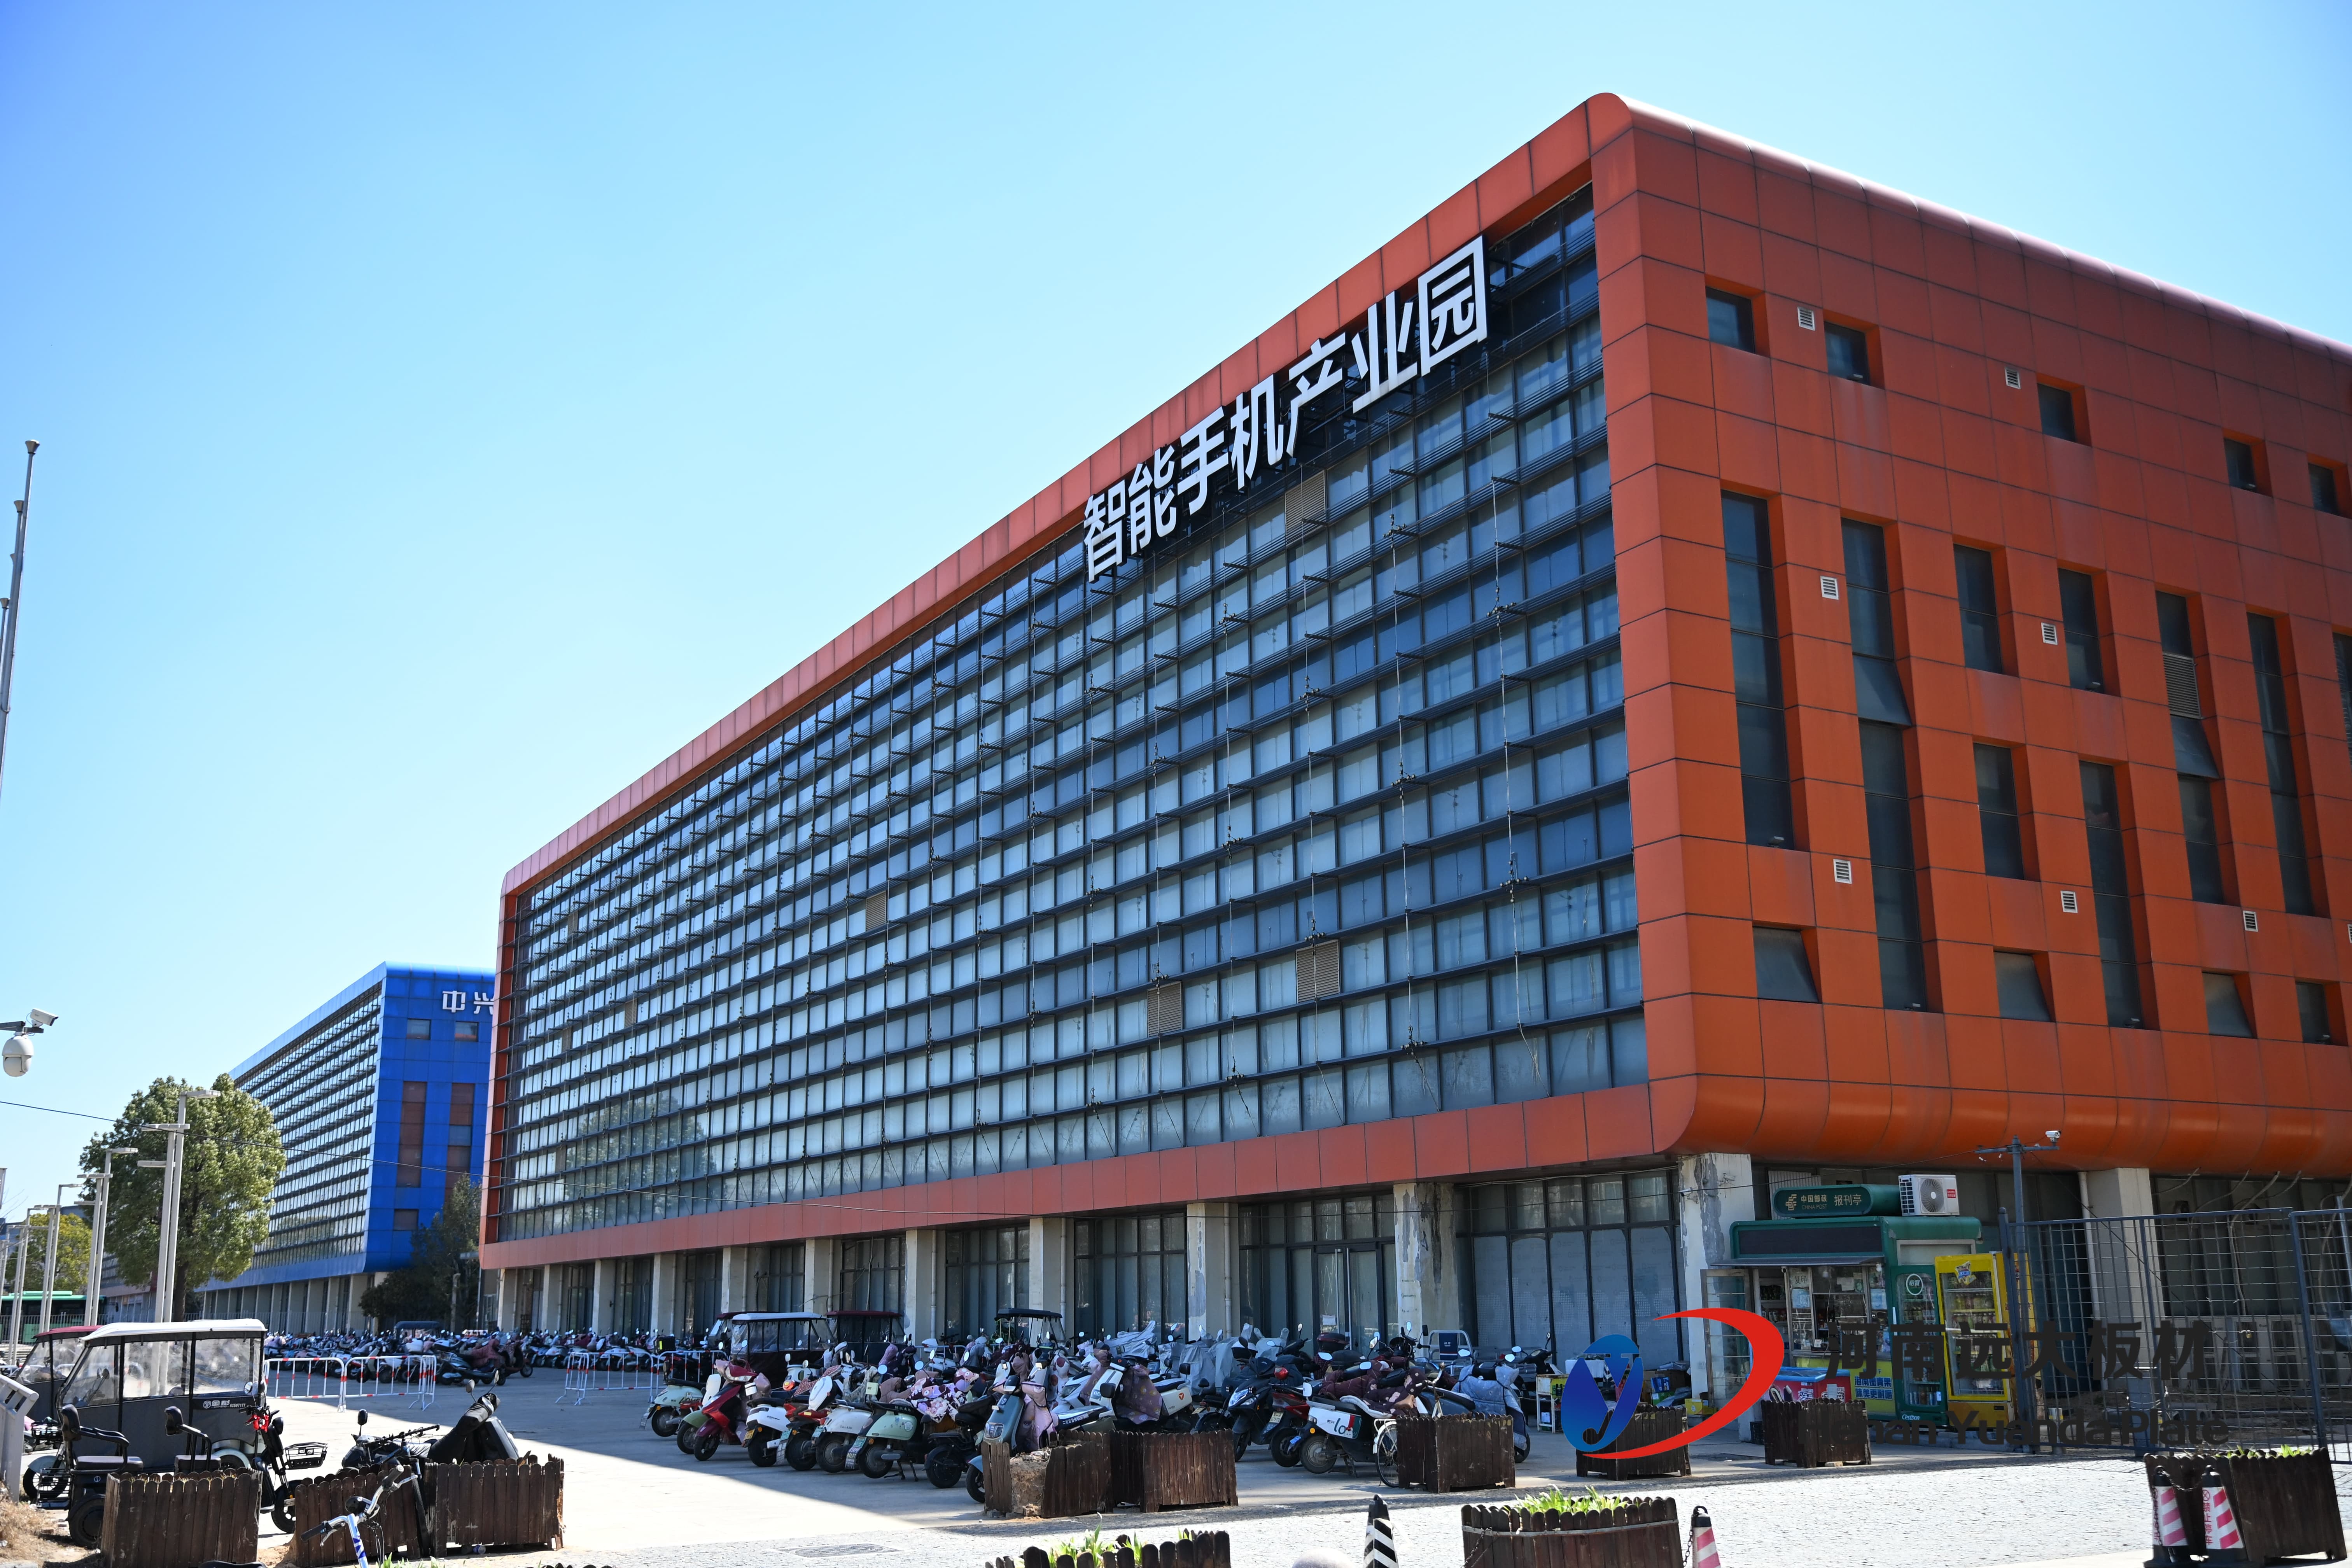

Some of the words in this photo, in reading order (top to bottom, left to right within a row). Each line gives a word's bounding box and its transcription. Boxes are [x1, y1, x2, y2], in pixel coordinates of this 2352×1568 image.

[1083, 234, 1487, 583] 智能手机产业园
[442, 990, 494, 1015] 中兴
[1801, 1194, 1827, 1203] 中国邮政
[1834, 1194, 1862, 1206] 报刊亭
[1795, 1275, 1807, 1284] 复印
[2203, 1502, 2213, 1545] 禁止停车
